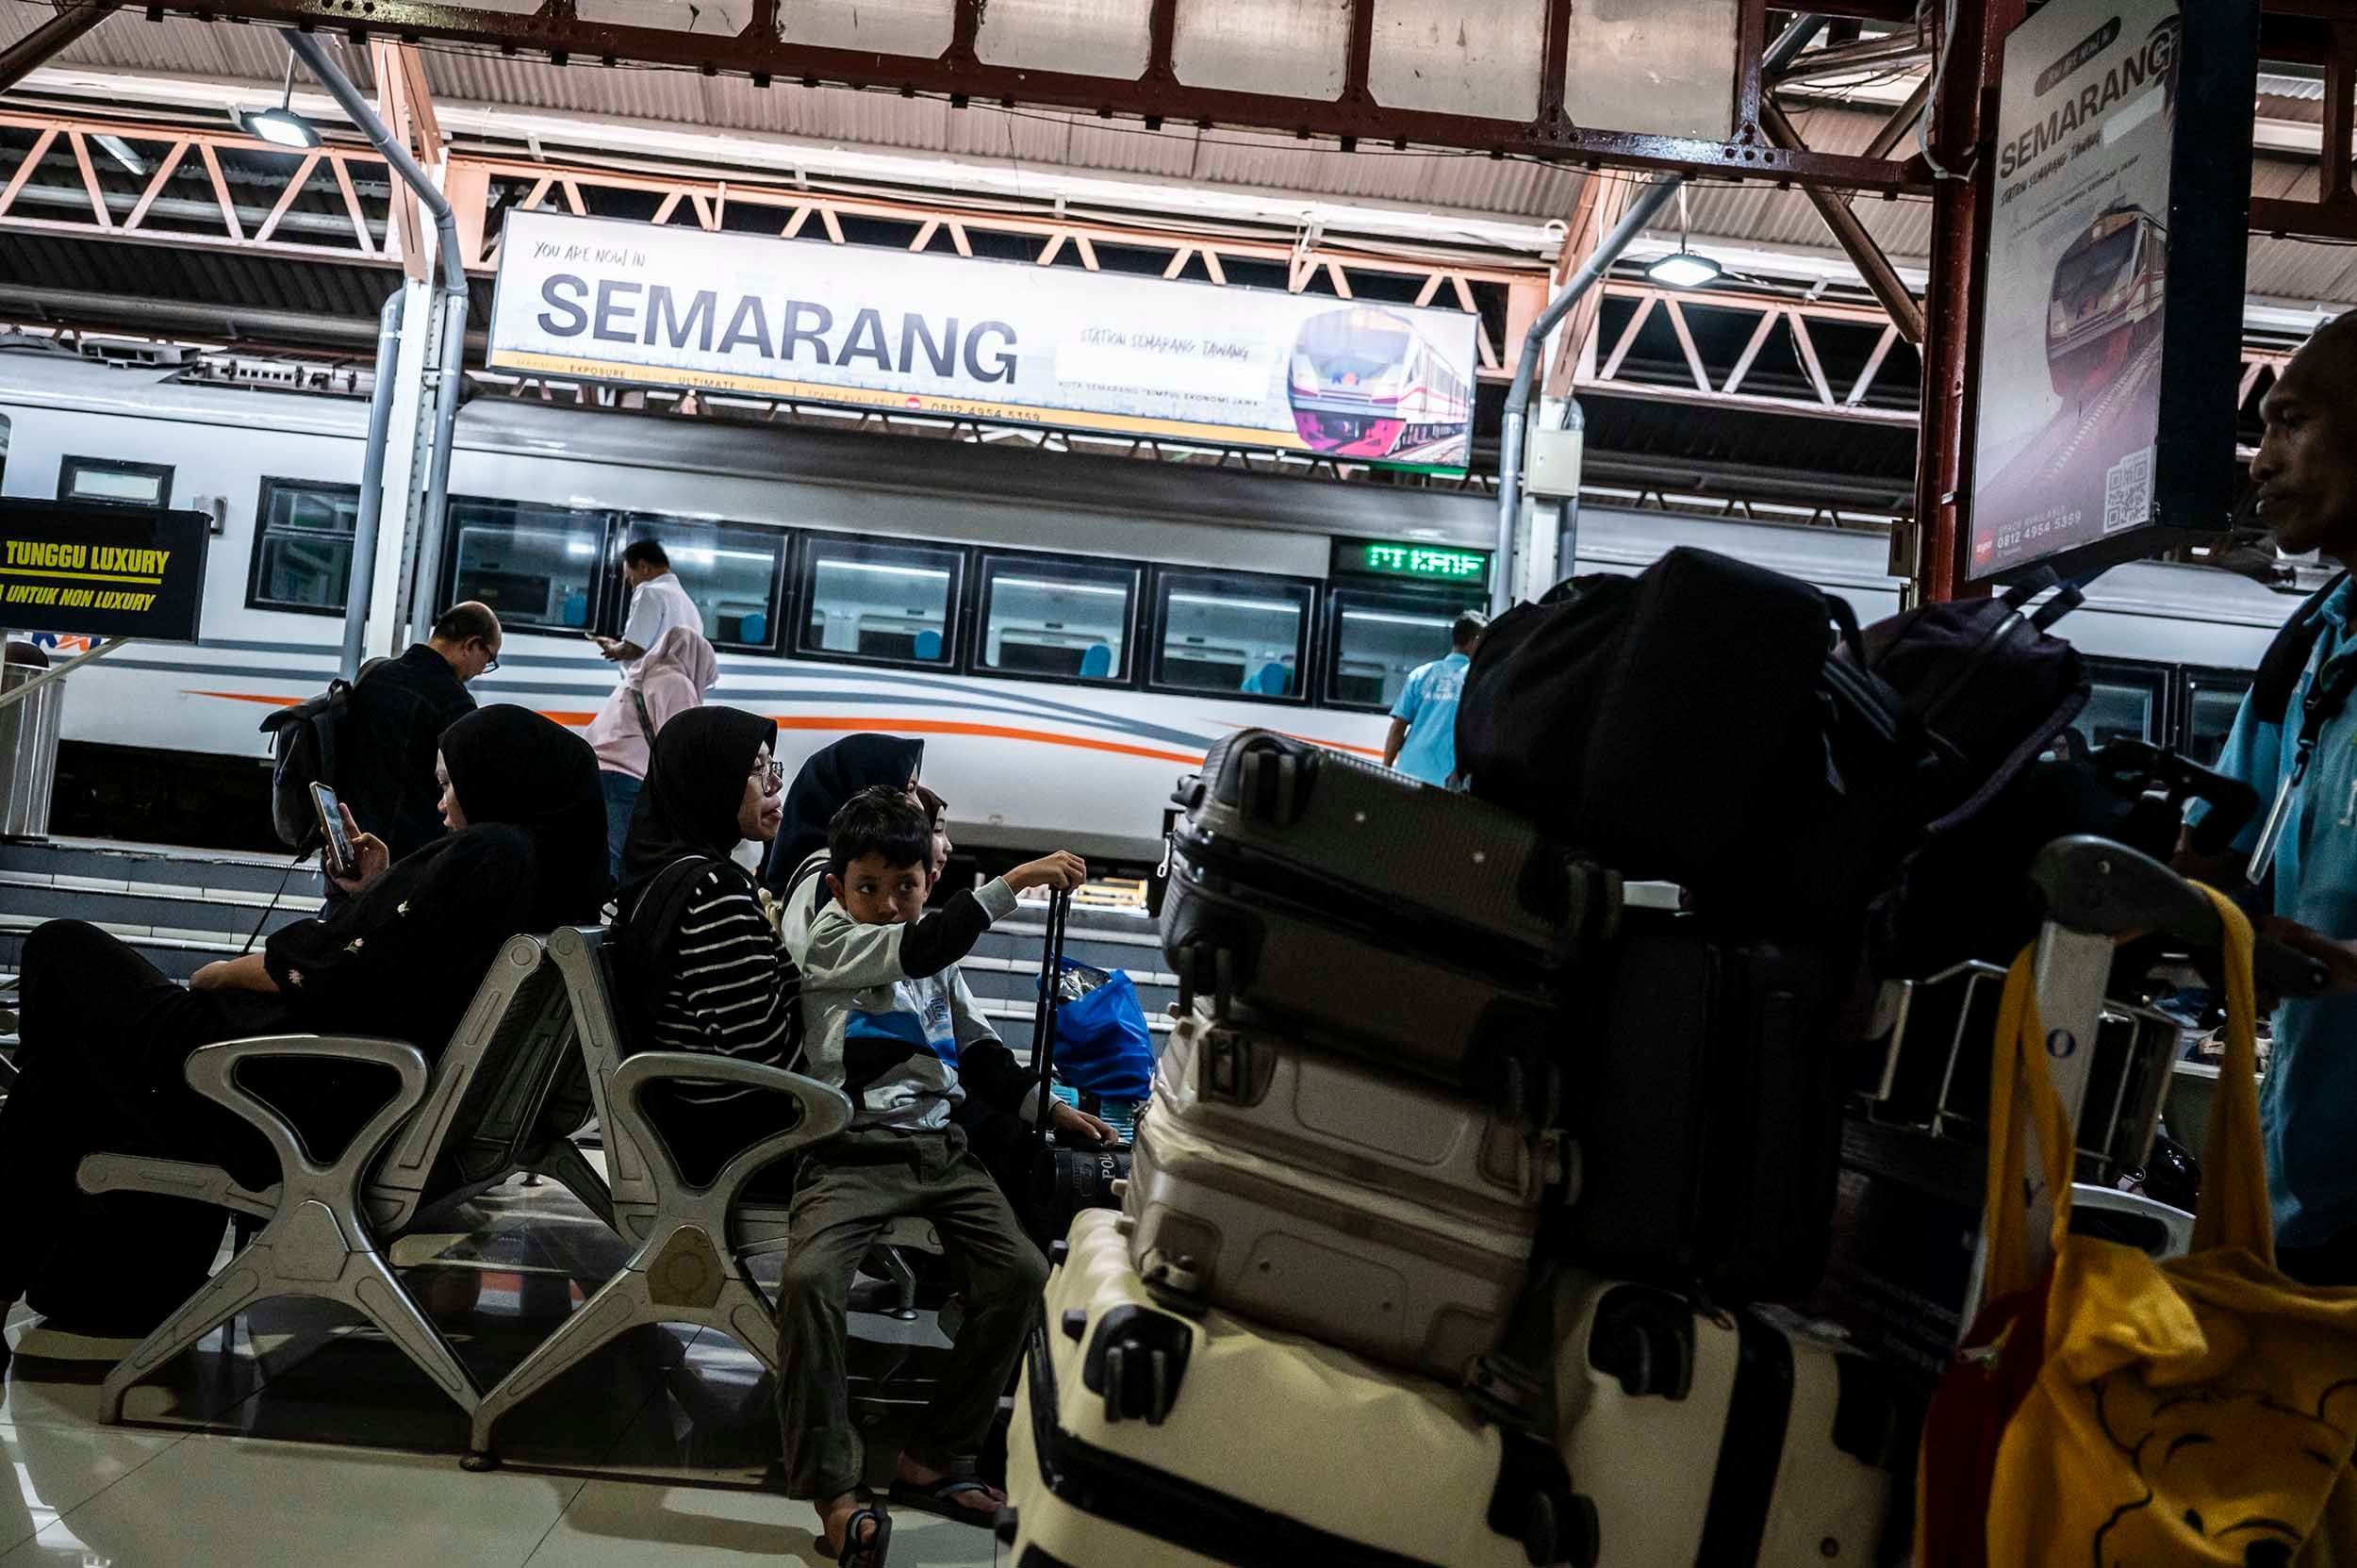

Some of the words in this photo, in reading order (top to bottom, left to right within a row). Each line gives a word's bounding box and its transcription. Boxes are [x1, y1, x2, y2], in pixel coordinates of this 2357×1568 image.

[2000, 30, 2171, 179] SEMARANG
[534, 240, 560, 258] YOU
[565, 244, 590, 261] ARE
[596, 248, 627, 266] NOW
[633, 250, 646, 267] IN
[537, 273, 1018, 384] SEMARANG
[569, 364, 625, 377] EXPOSURE
[679, 376, 735, 389] ULTIMATE
[7, 540, 87, 569] TUNGGU
[91, 545, 171, 574] LUXURY
[7, 585, 60, 605] UNTUK
[59, 588, 95, 607] NON
[95, 591, 157, 611] LUXURY
